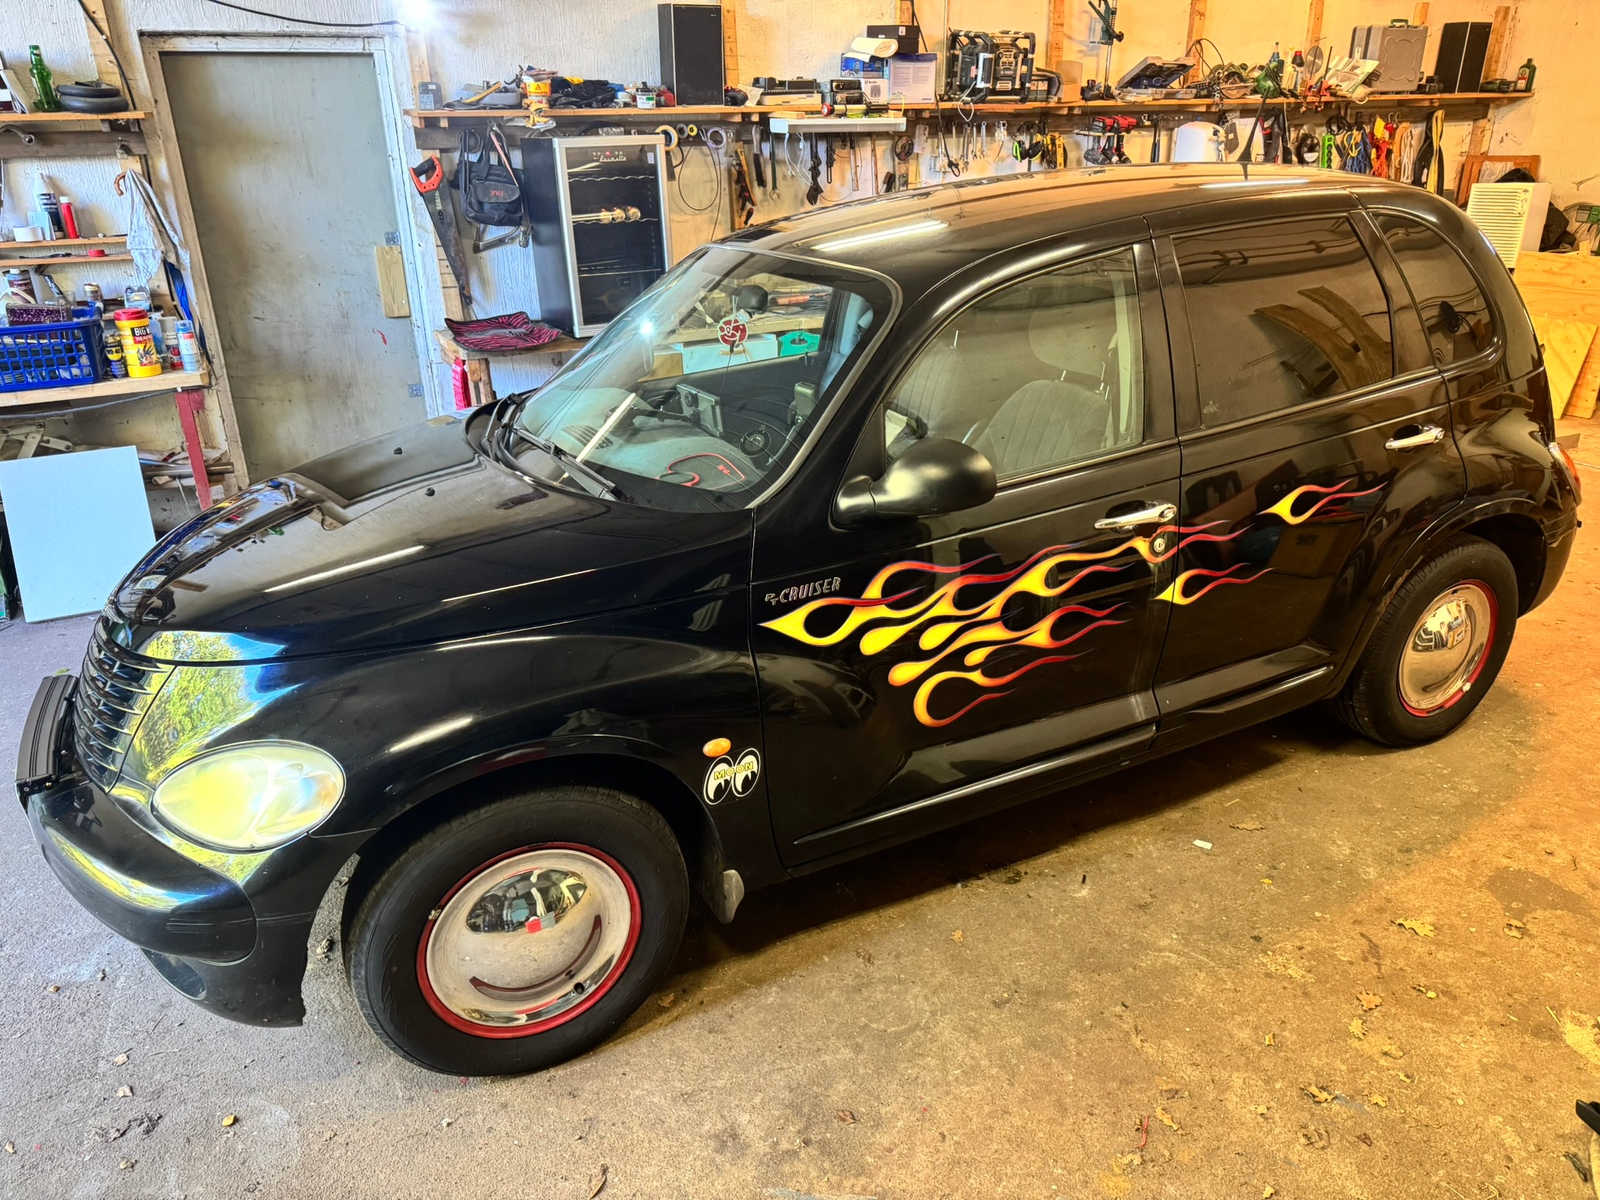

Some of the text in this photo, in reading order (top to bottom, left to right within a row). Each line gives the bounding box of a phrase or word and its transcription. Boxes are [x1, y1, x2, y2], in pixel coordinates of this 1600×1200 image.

[134, 327, 146, 336] BIG
[106, 347, 121, 355] WD-40
[780, 577, 841, 603] CRUISER
[714, 761, 754, 780] MOON
